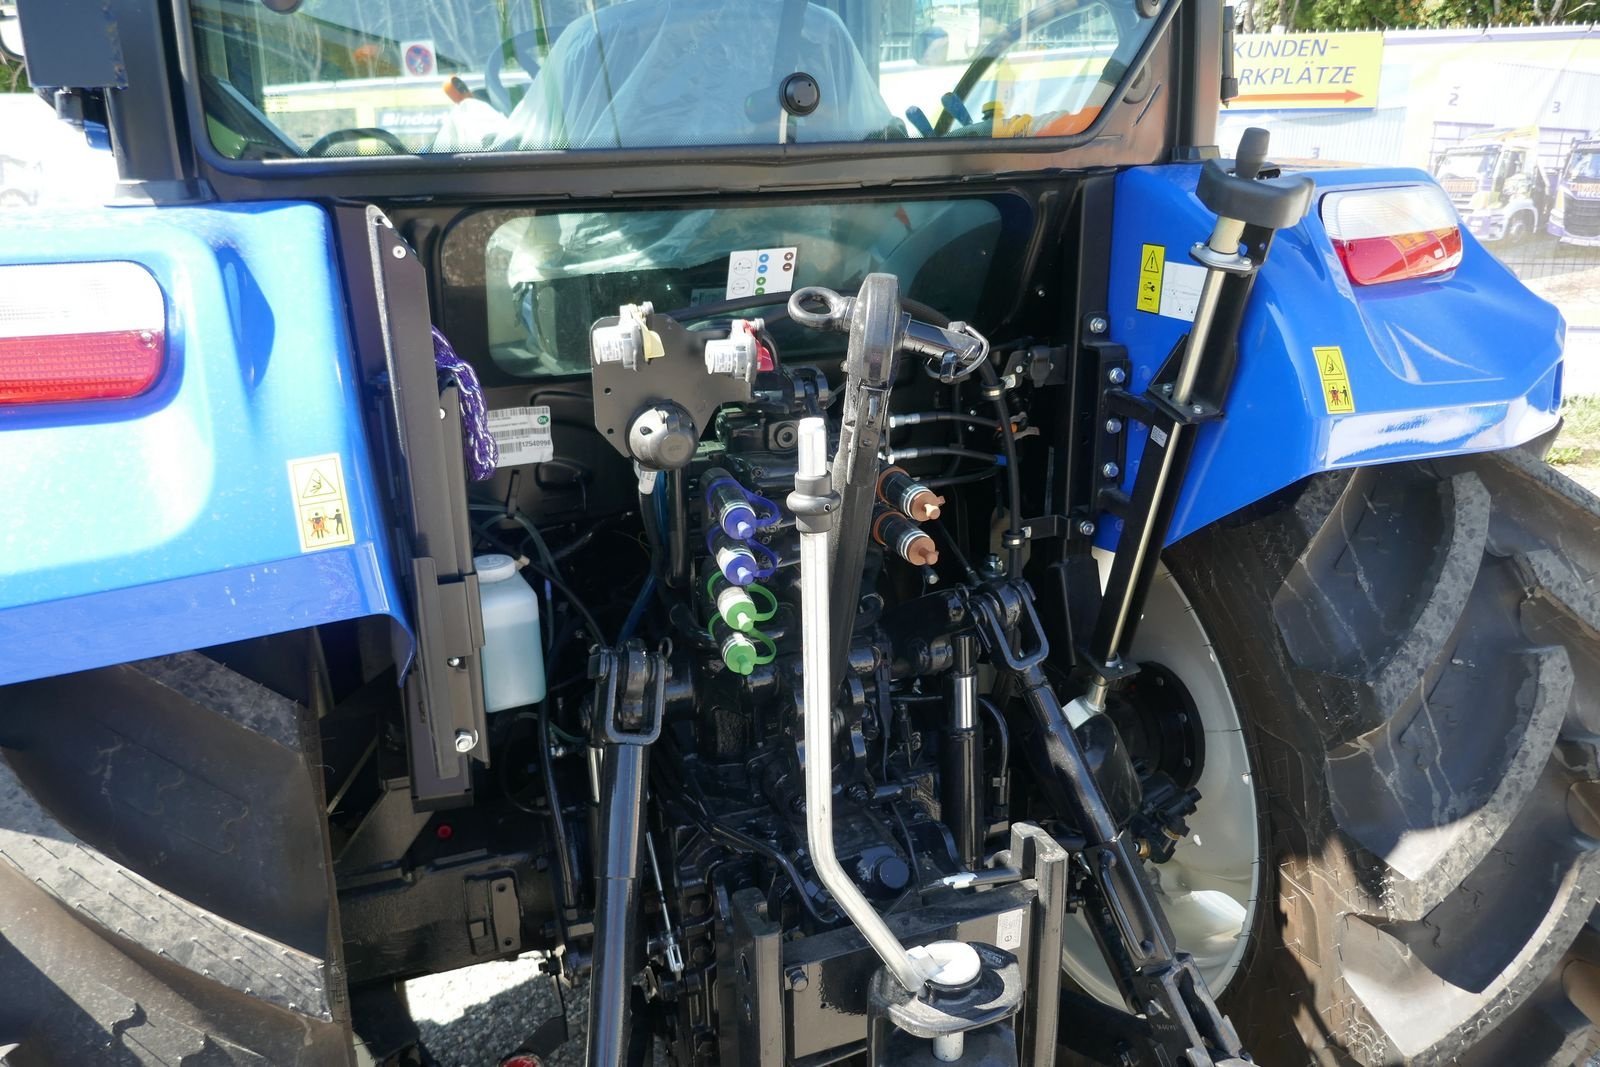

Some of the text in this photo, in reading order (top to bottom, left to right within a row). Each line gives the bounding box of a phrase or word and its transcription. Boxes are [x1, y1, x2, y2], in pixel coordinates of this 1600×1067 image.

[1238, 60, 1357, 86] RKPLÄTZE
[1448, 93, 1459, 106] 2
[1552, 101, 1561, 113] 3
